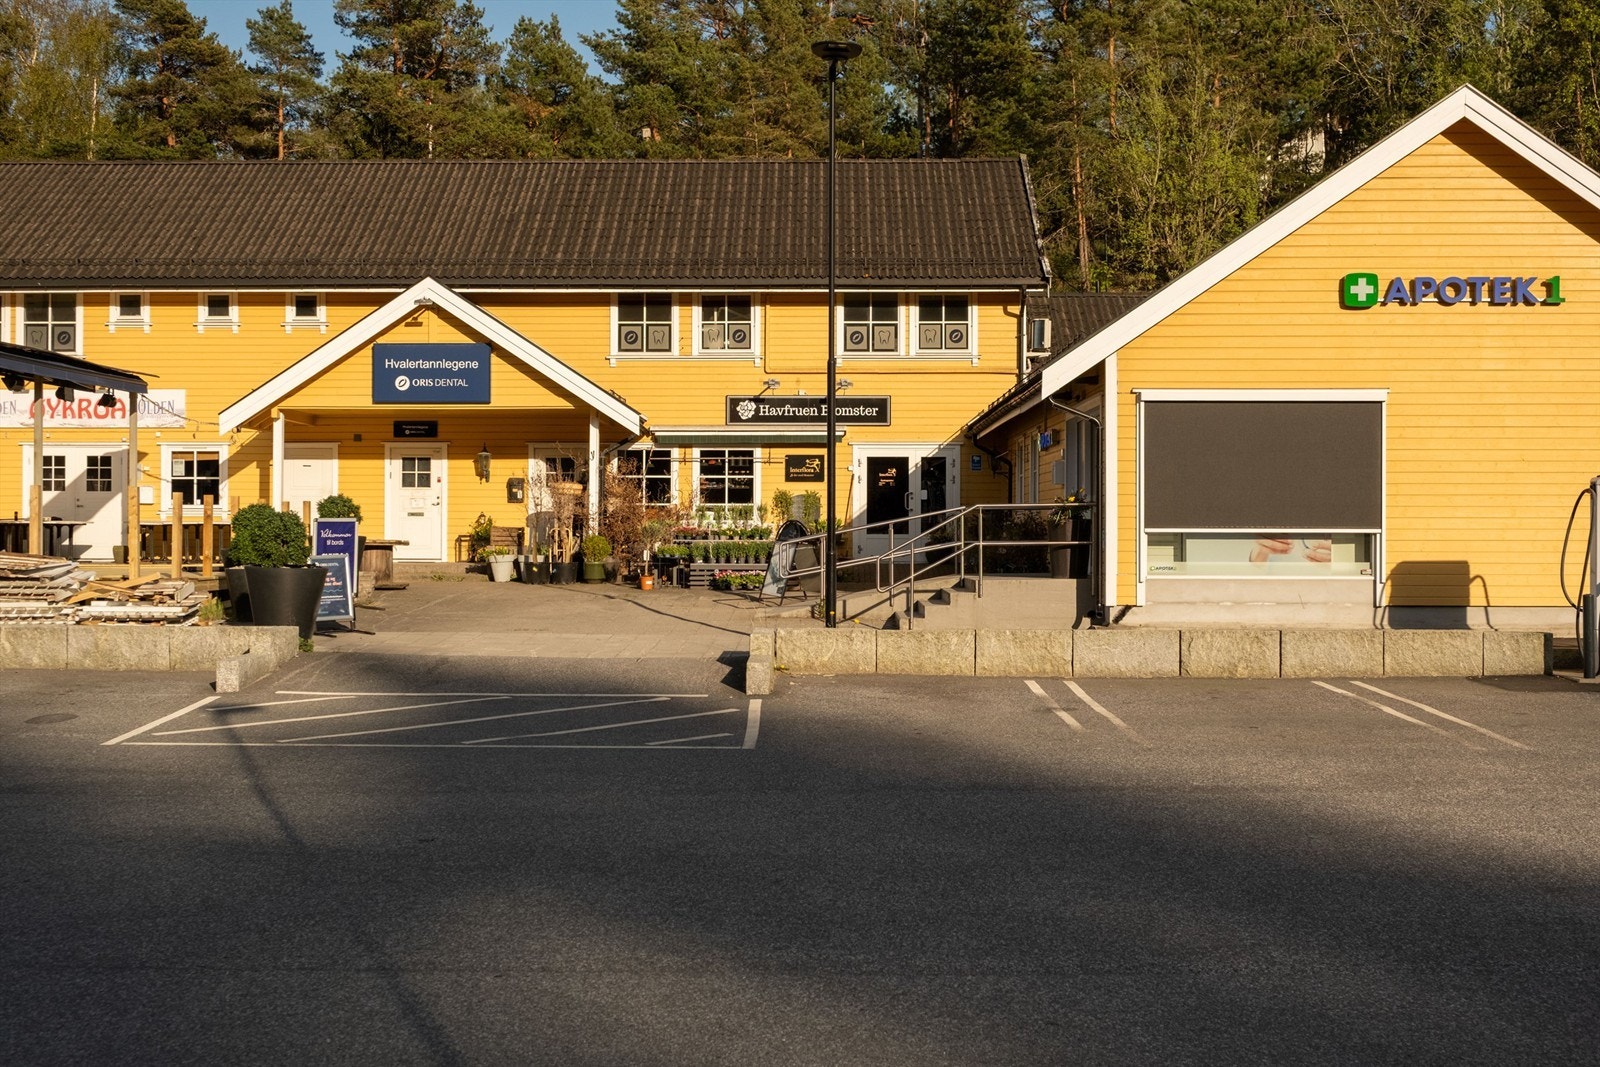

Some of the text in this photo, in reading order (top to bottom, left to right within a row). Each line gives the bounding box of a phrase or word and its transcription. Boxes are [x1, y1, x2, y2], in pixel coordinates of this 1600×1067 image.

[1383, 276, 1540, 303] APOTEK
[384, 358, 479, 372] Hvalertannlegene
[412, 378, 468, 387] ORIS DENTAL
[758, 404, 879, 416] Havfruen Bomster
